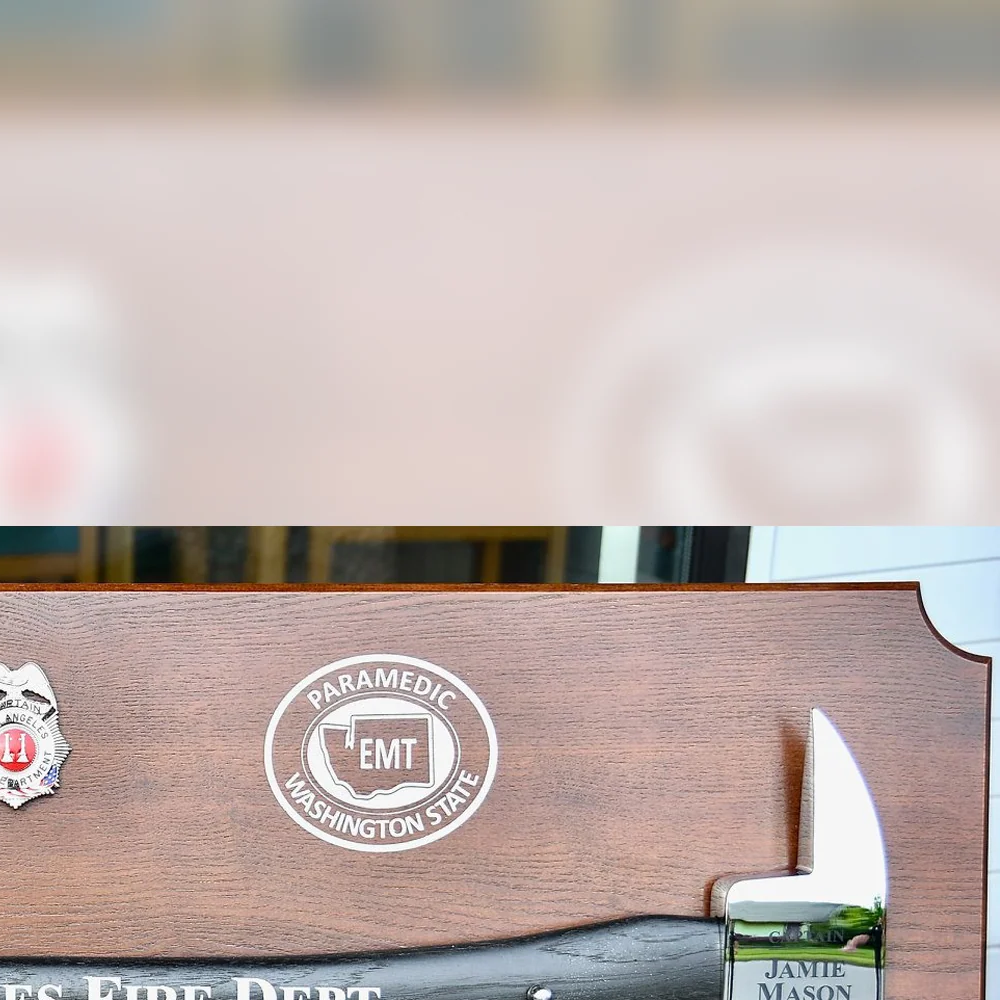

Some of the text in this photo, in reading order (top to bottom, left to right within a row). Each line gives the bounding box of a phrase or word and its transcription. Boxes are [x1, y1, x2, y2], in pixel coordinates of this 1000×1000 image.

[306, 668, 456, 710] PARAMEDIC
[5, 713, 49, 740] ANGELES
[360, 738, 417, 770] EMT
[284, 770, 480, 839] WASHINGTON STATE
[765, 959, 846, 979] JAMIE
